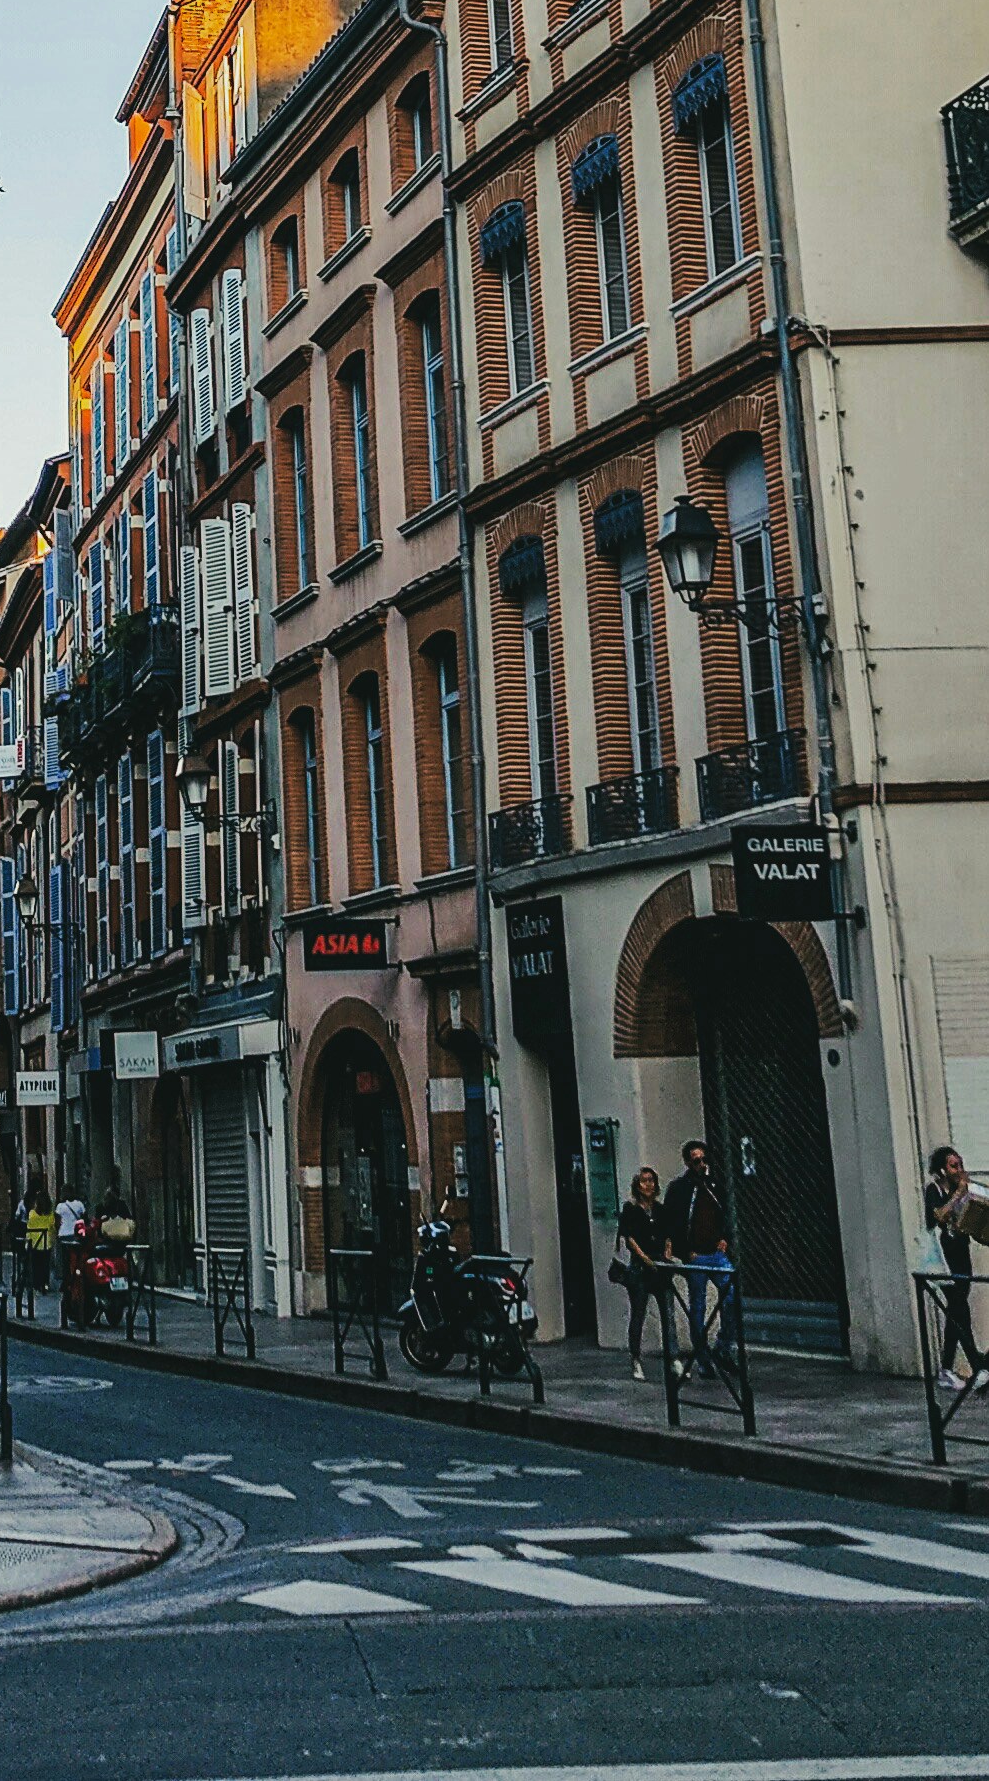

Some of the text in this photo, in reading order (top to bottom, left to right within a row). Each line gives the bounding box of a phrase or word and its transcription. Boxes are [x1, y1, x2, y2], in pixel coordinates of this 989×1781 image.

[747, 837, 824, 852] GALERIE
[753, 863, 820, 880] VALAT
[312, 934, 358, 954] ASIA
[512, 951, 553, 978] VALAT
[118, 1057, 156, 1068] SAKAH
[19, 1080, 57, 1092] ATYPIQUE
